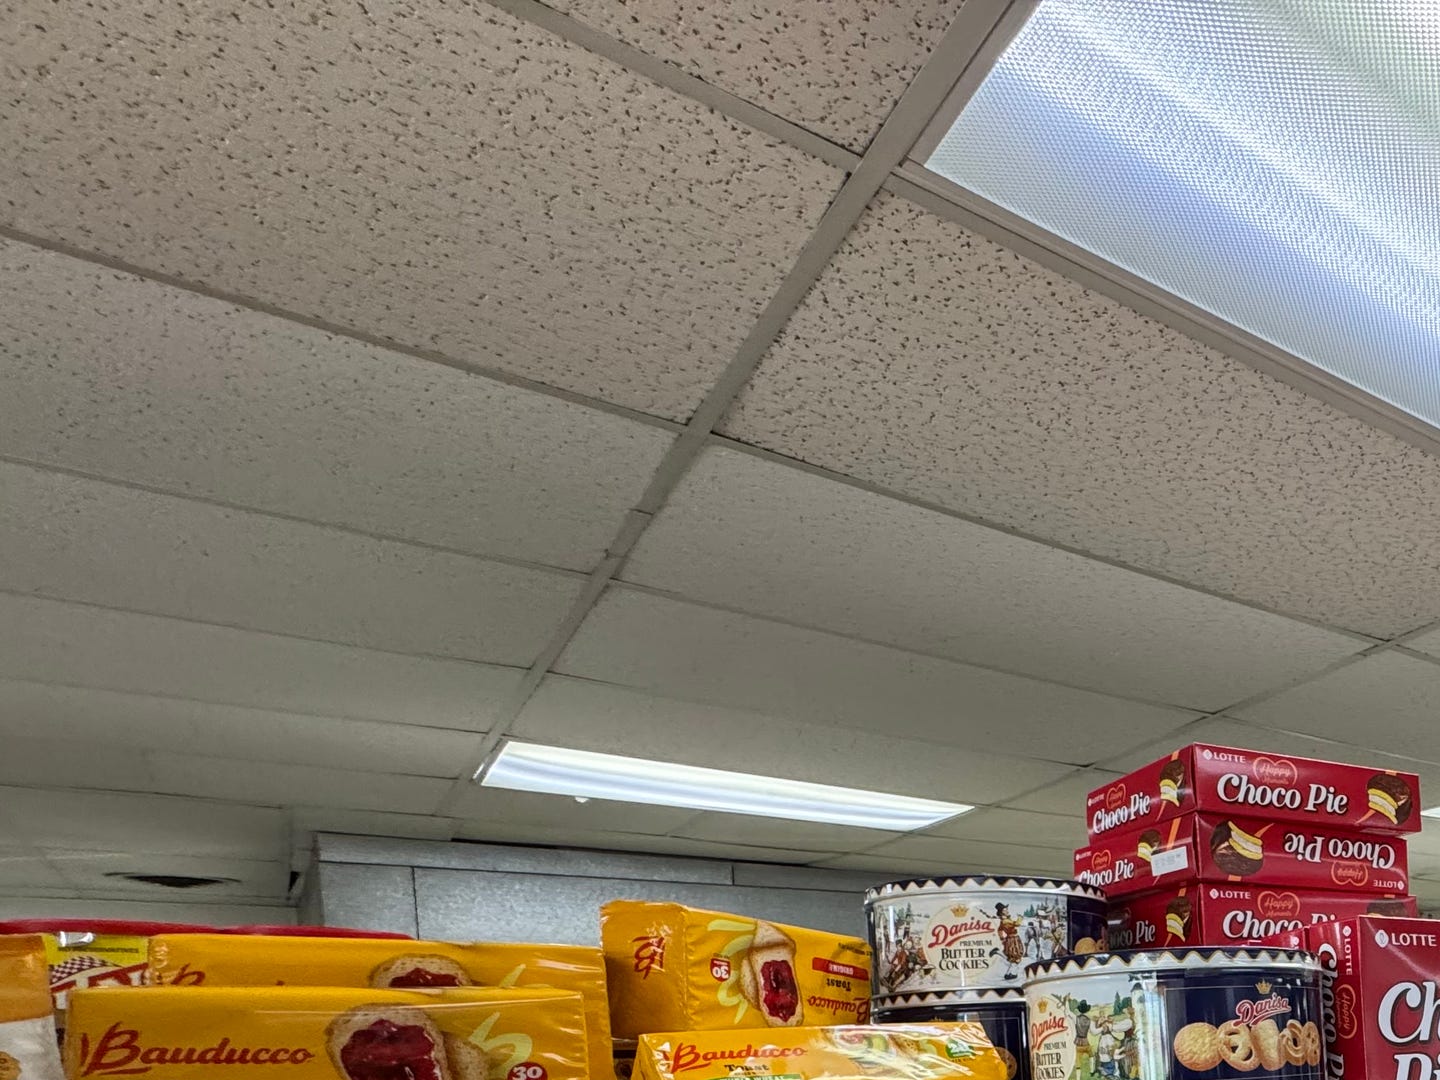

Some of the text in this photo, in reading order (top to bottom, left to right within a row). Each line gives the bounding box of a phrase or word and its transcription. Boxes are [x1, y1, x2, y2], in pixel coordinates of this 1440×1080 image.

[1213, 751, 1247, 764] LOTTE
[1216, 773, 1348, 815] Choco Pie
[1092, 794, 1151, 835] Choco Pie
[1284, 832, 1396, 870] Choco Pie
[1114, 858, 1135, 881] Pie
[1220, 889, 1250, 900] LOTTE
[928, 917, 996, 949] Danisa
[1134, 919, 1156, 945] Pie
[1391, 932, 1437, 947] LOTTE
[959, 939, 993, 947] PREMIUM
[940, 947, 985, 960] BUTTER
[713, 966, 730, 979] 30
[938, 958, 989, 971] COOKIES
[1233, 992, 1292, 1027] Danisa
[1031, 1012, 1068, 1049] Danisa
[80, 1021, 315, 1078] Bauducco
[1044, 1041, 1066, 1049] PREMIUM
[671, 1042, 808, 1075] Bauducco
[1035, 1052, 1061, 1066] BUTTER
[1035, 1066, 1065, 1080] COOKIES
